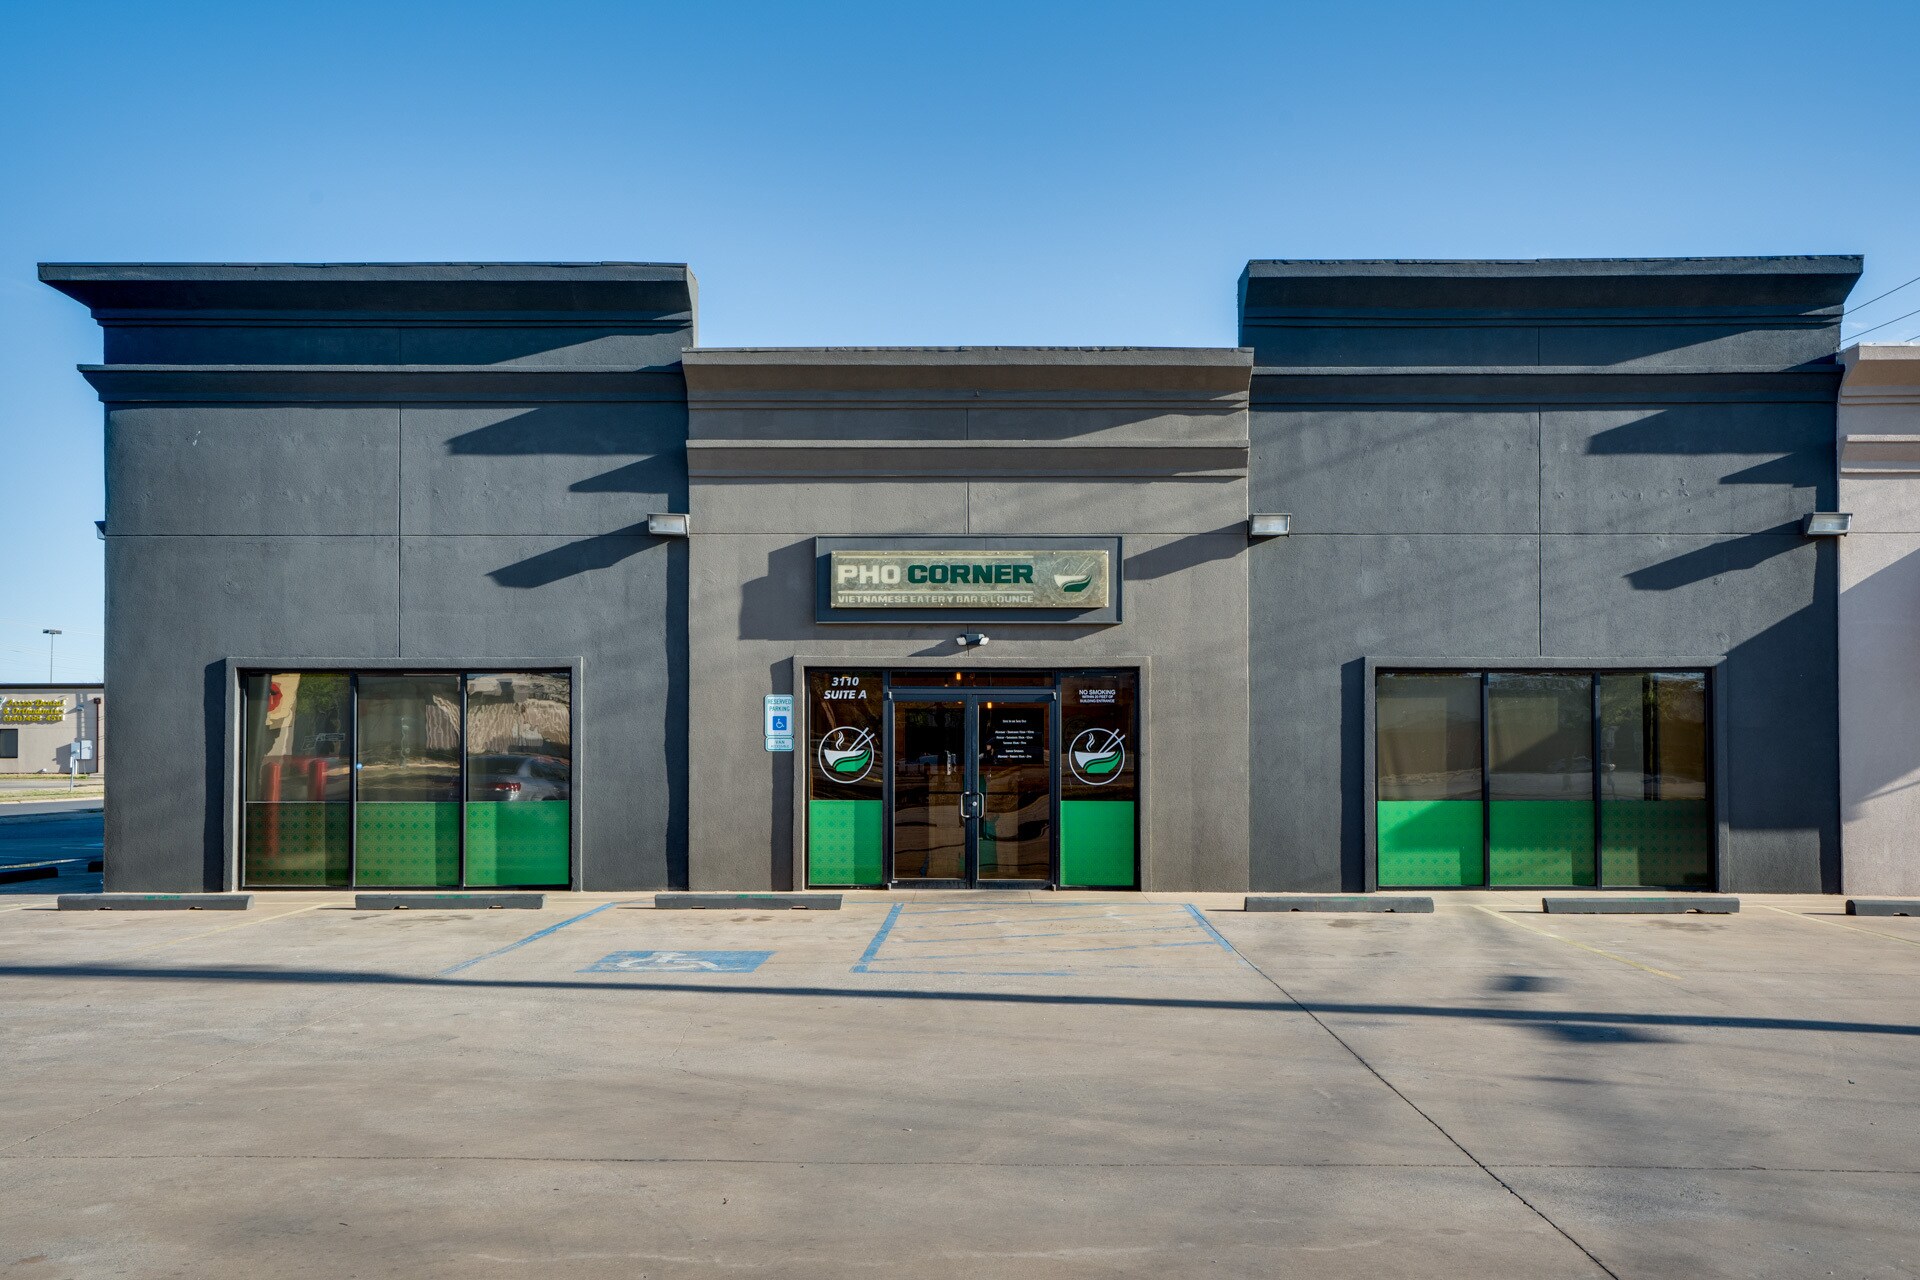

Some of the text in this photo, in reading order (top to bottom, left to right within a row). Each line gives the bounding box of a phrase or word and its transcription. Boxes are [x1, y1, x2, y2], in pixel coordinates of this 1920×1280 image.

[837, 564, 1034, 584] PHO CORNER
[837, 595, 908, 603] VIETNAMESE
[910, 595, 954, 603] EATERY
[956, 595, 978, 603] BAR
[831, 677, 860, 686] 3110
[823, 690, 867, 699] SUITE A
